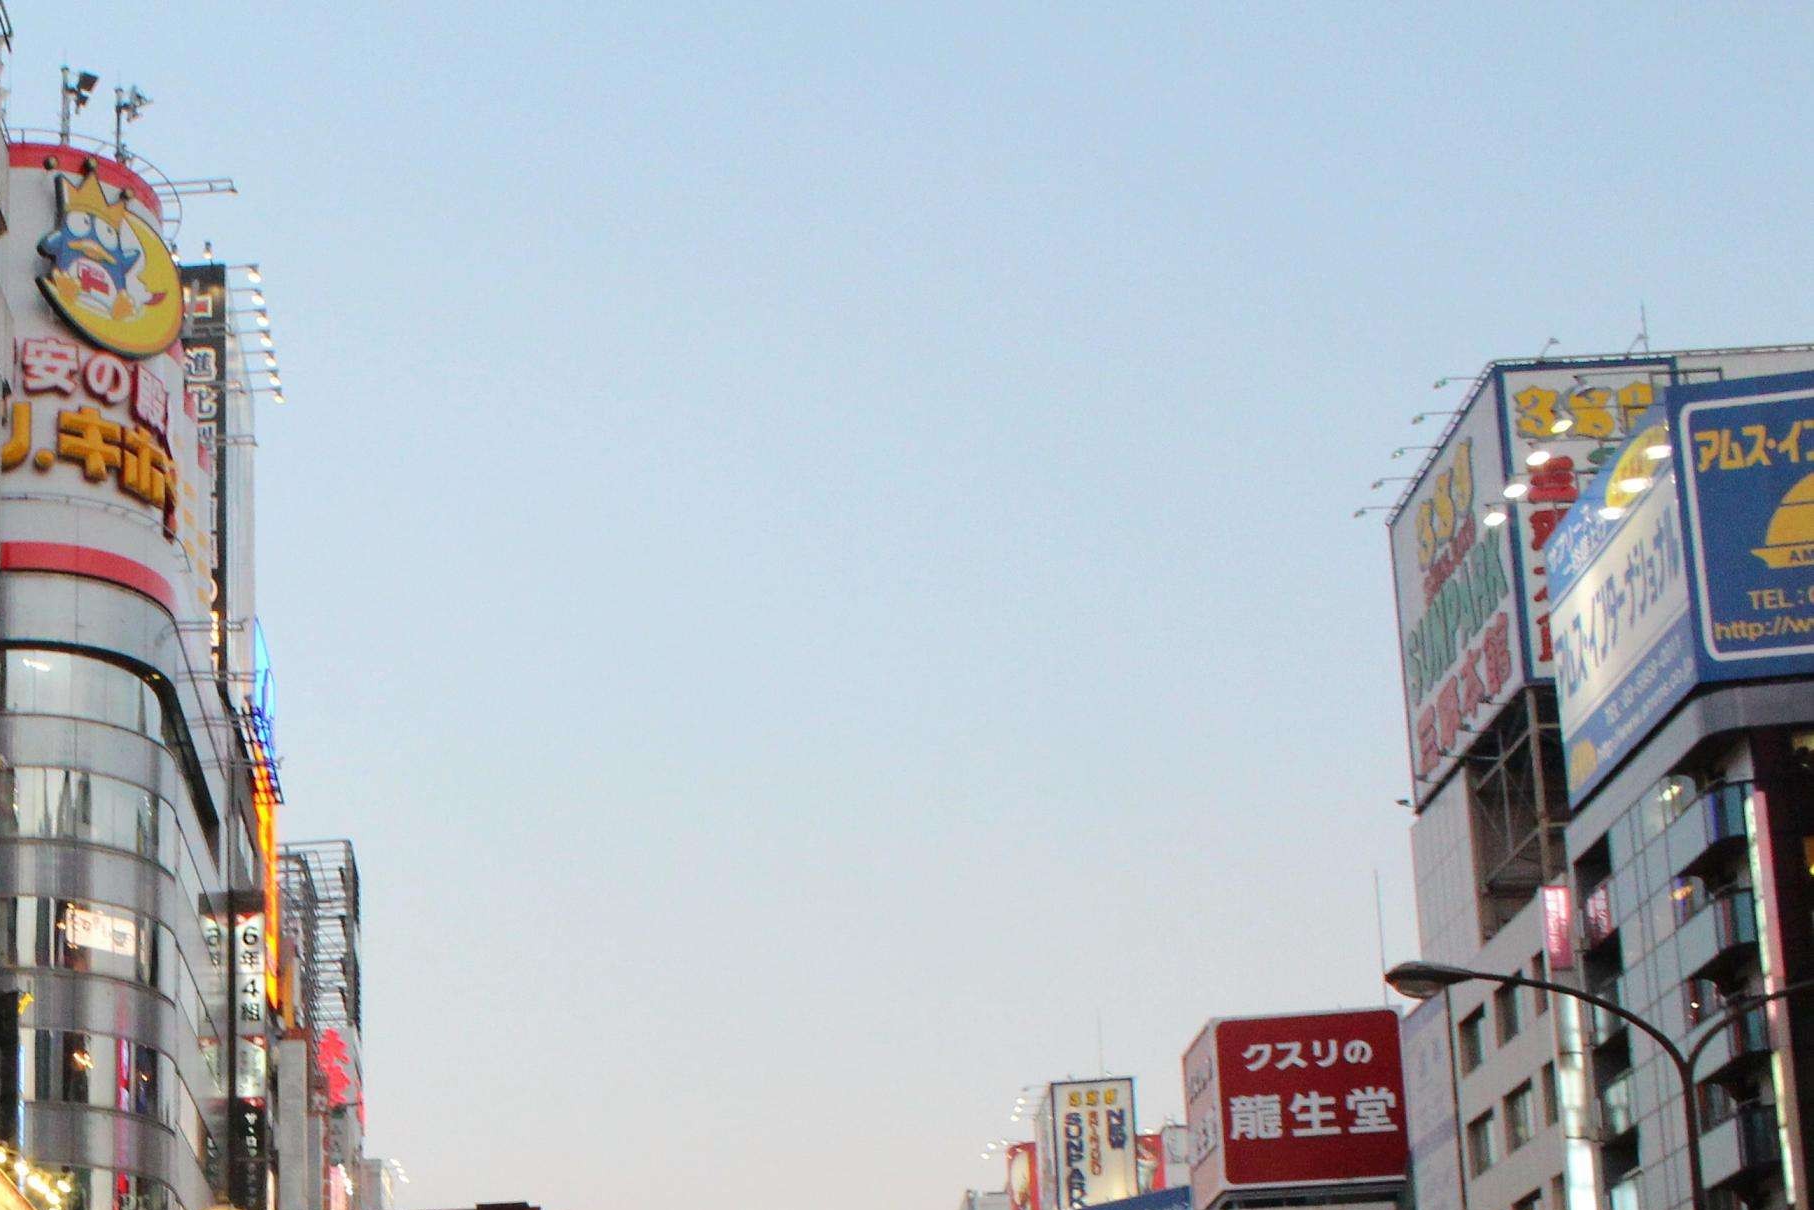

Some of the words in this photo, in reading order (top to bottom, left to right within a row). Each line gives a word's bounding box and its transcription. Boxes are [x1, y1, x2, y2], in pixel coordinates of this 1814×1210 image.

[1241, 1038, 1374, 1073] クスリの
[1228, 1085, 1399, 1142] 龍生堂
